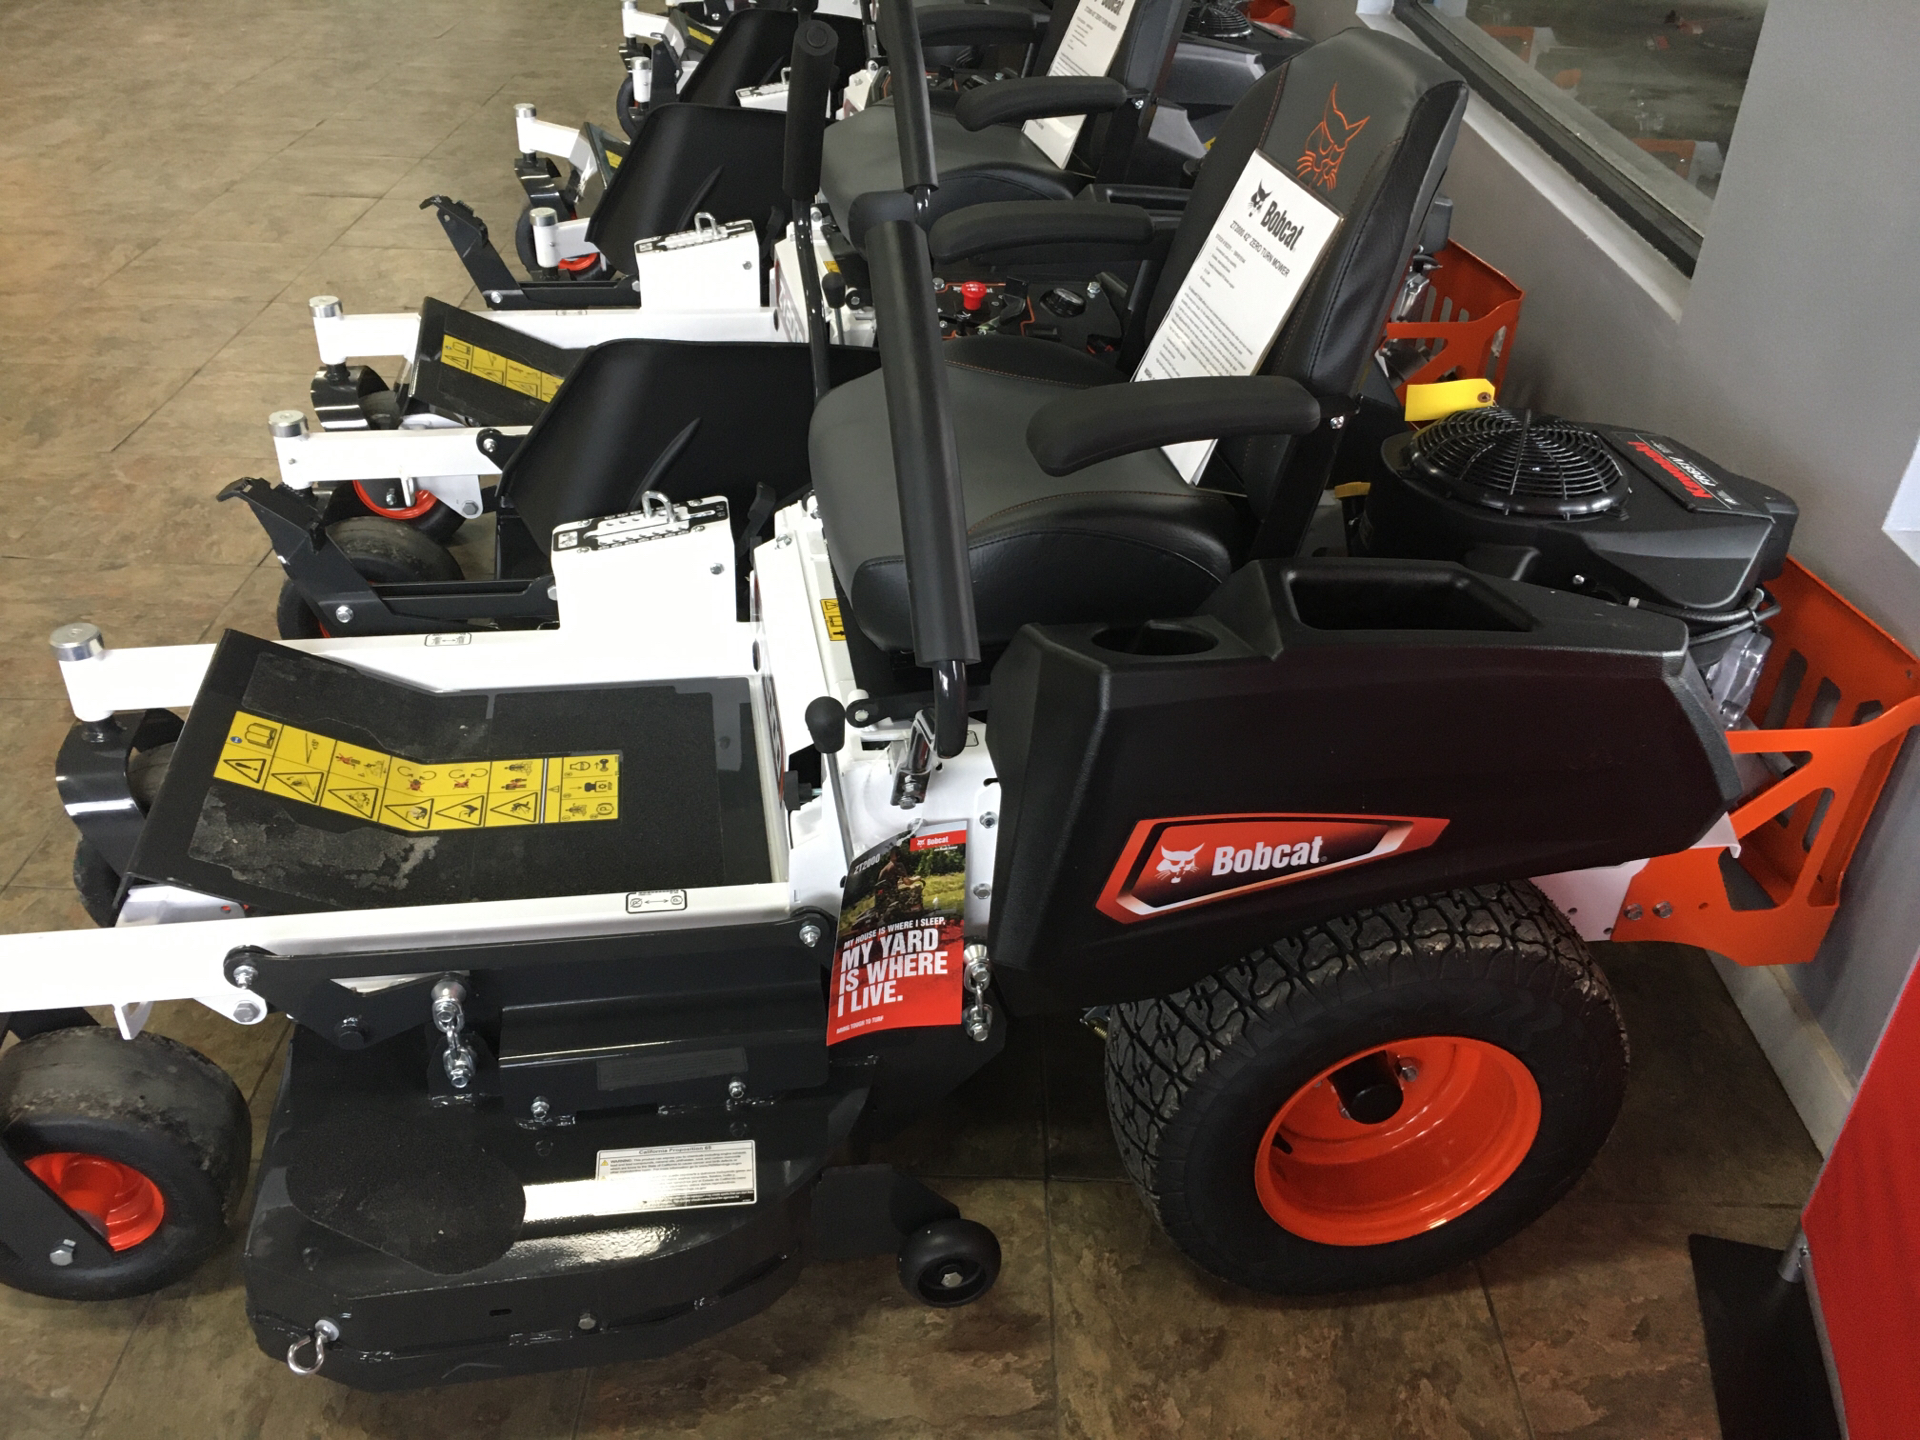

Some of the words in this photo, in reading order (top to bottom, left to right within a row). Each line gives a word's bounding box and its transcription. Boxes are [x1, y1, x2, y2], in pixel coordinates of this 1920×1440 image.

[1260, 200, 1305, 251] Bobcat
[1249, 237, 1263, 253] ZERO
[1260, 247, 1274, 263] TURN
[1271, 257, 1291, 278] MOWER
[926, 835, 949, 846] Bobcat
[1211, 835, 1324, 876] Bobcat
[853, 853, 881, 875] ZT2000
[841, 940, 873, 973] MY
[880, 928, 939, 959] YARD
[843, 938, 855, 950] MY
[855, 929, 877, 944] HOUSE
[878, 926, 886, 936] IS
[887, 920, 914, 932] WHERE
[915, 919, 919, 928] I
[839, 968, 860, 996] IS
[866, 950, 949, 985] WHERE
[837, 995, 845, 1018] I
[850, 980, 903, 1013] LIVE.
